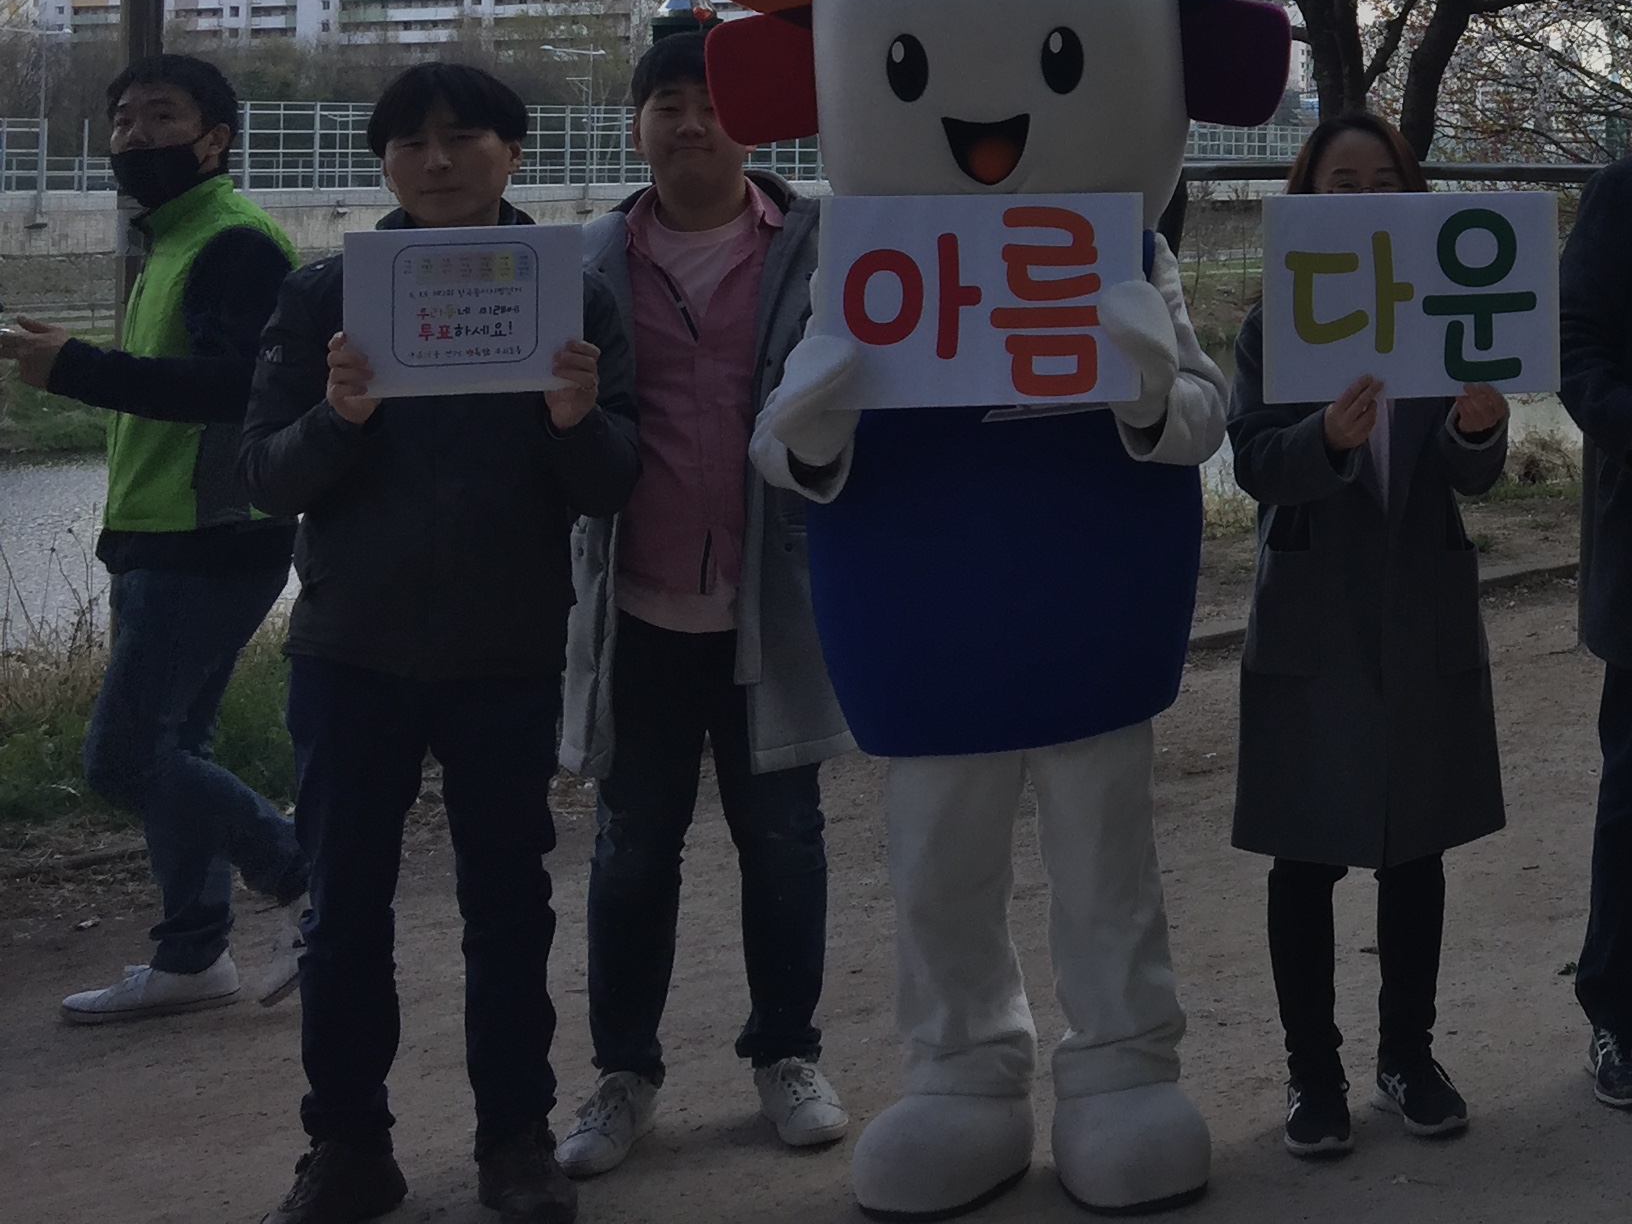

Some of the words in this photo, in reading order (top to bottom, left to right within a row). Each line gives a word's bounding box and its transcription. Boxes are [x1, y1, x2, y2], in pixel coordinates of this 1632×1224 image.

[418, 320, 513, 342] 투표하세요!
[842, 206, 1100, 397] 아름
[1284, 208, 1537, 383] 다운
